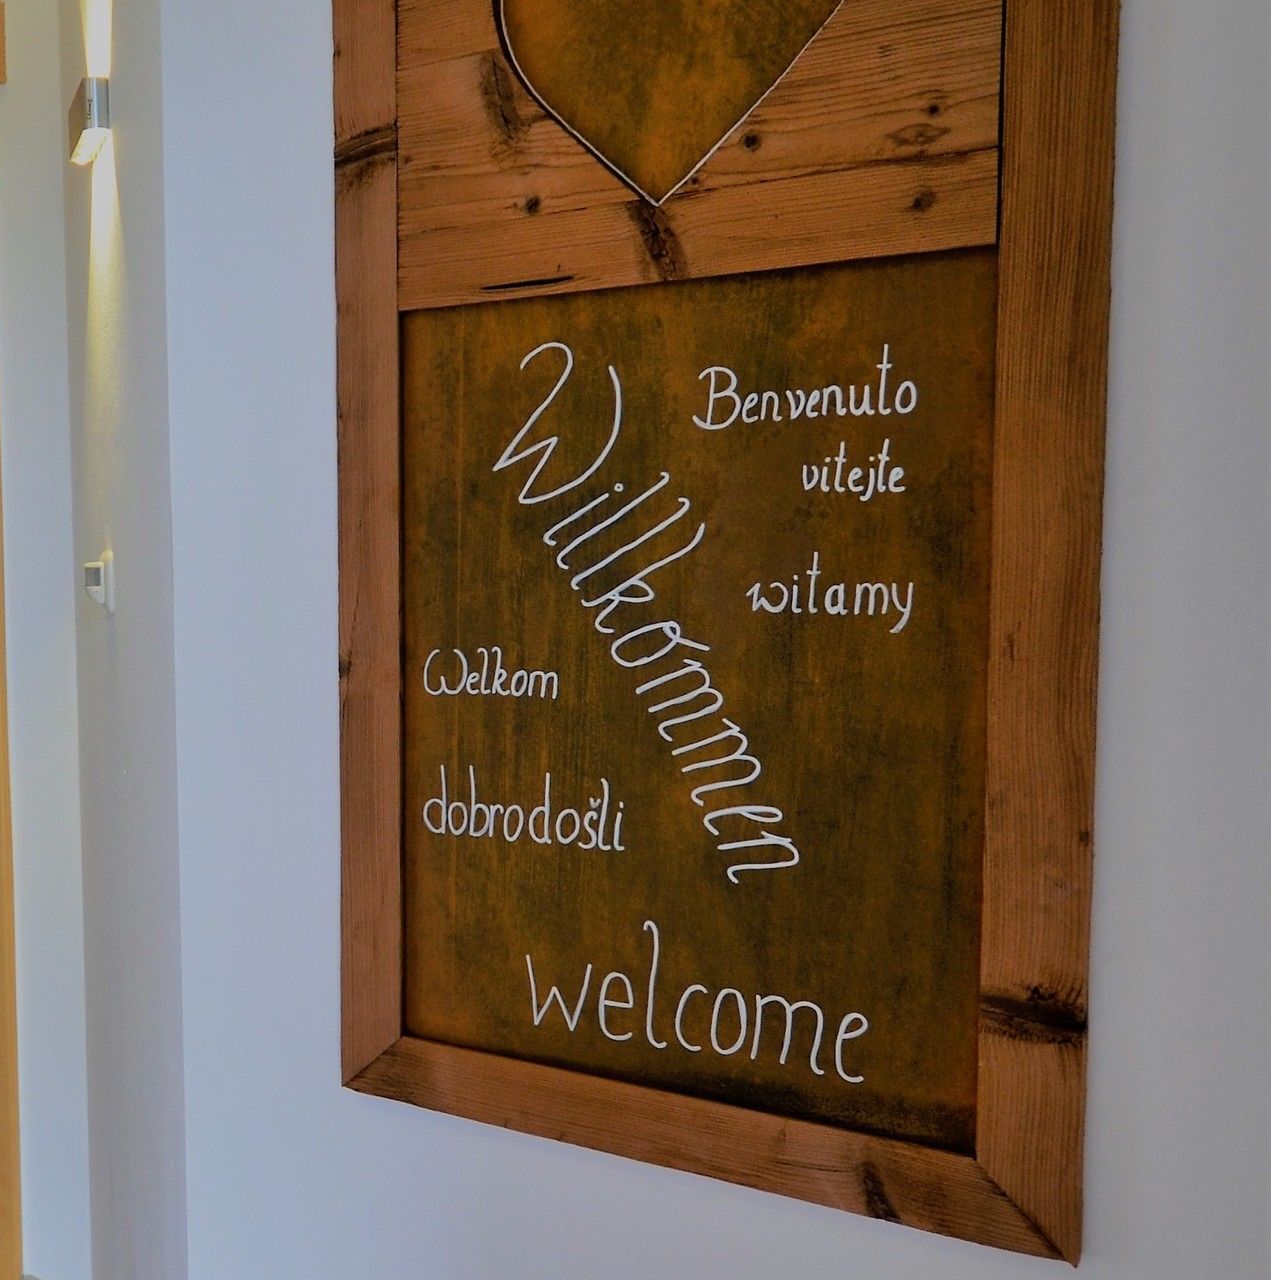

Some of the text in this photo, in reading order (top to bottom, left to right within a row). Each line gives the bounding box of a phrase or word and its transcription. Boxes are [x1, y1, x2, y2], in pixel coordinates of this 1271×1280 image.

[692, 344, 918, 430] Benvenuto
[801, 438, 906, 502] vitejte
[492, 342, 800, 885] Willkommen
[746, 551, 914, 634] witamy
[423, 647, 559, 700] Welkom
[423, 765, 625, 853] dobrodošli
[525, 920, 869, 1083] welcome
